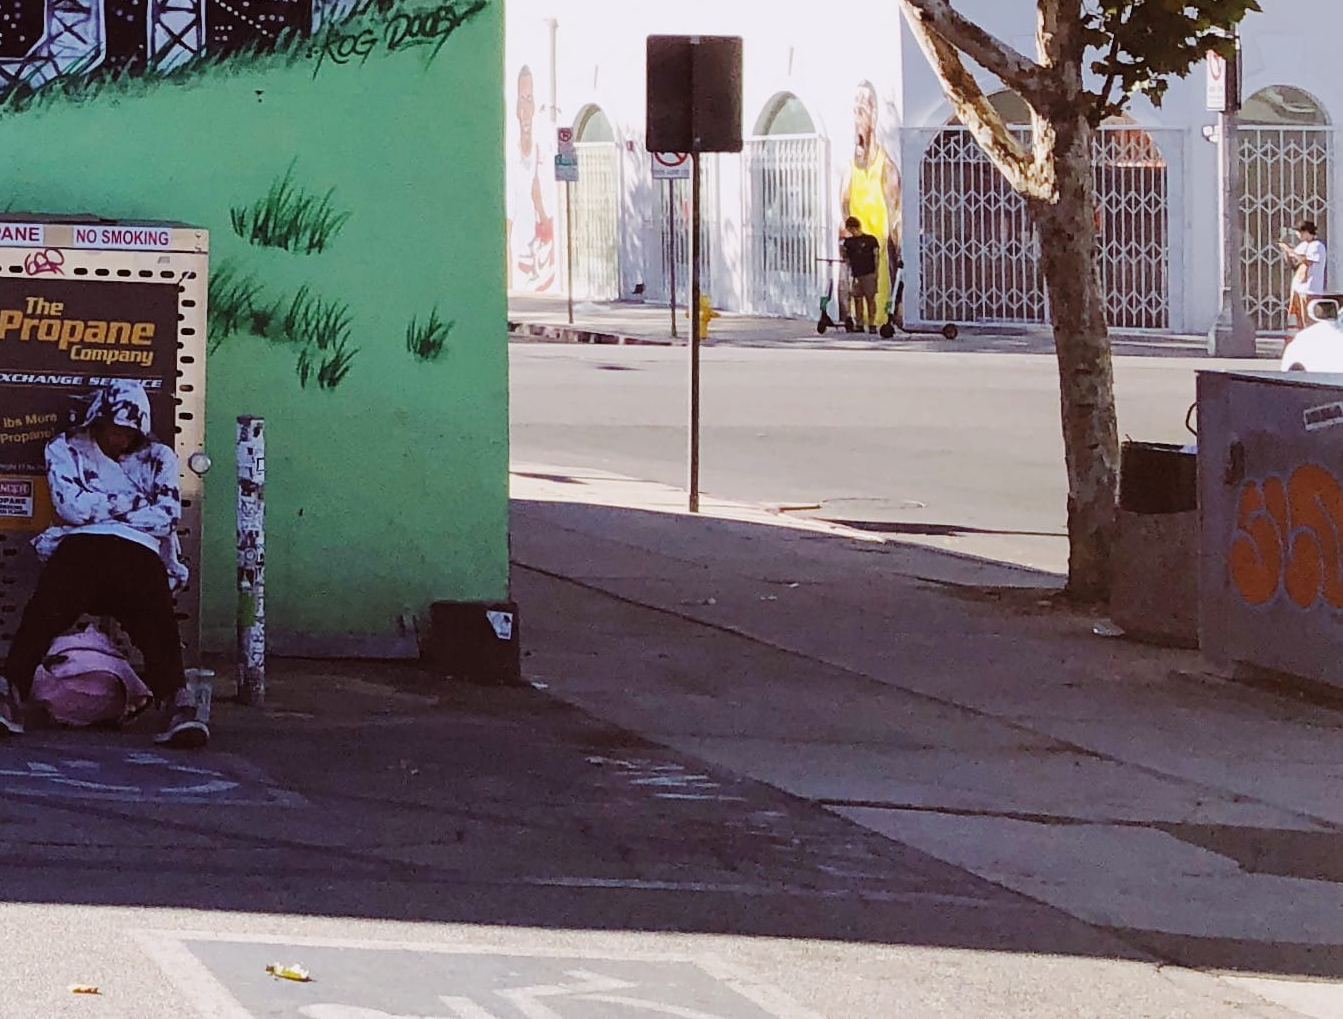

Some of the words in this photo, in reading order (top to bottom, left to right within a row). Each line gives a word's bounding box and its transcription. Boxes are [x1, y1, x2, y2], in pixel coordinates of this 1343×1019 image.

[76, 229, 98, 245] NO
[101, 230, 169, 246] SMOKING
[25, 297, 64, 316] The
[71, 345, 154, 366] Company
[3, 417, 22, 427] lbs
[25, 413, 58, 424] More
